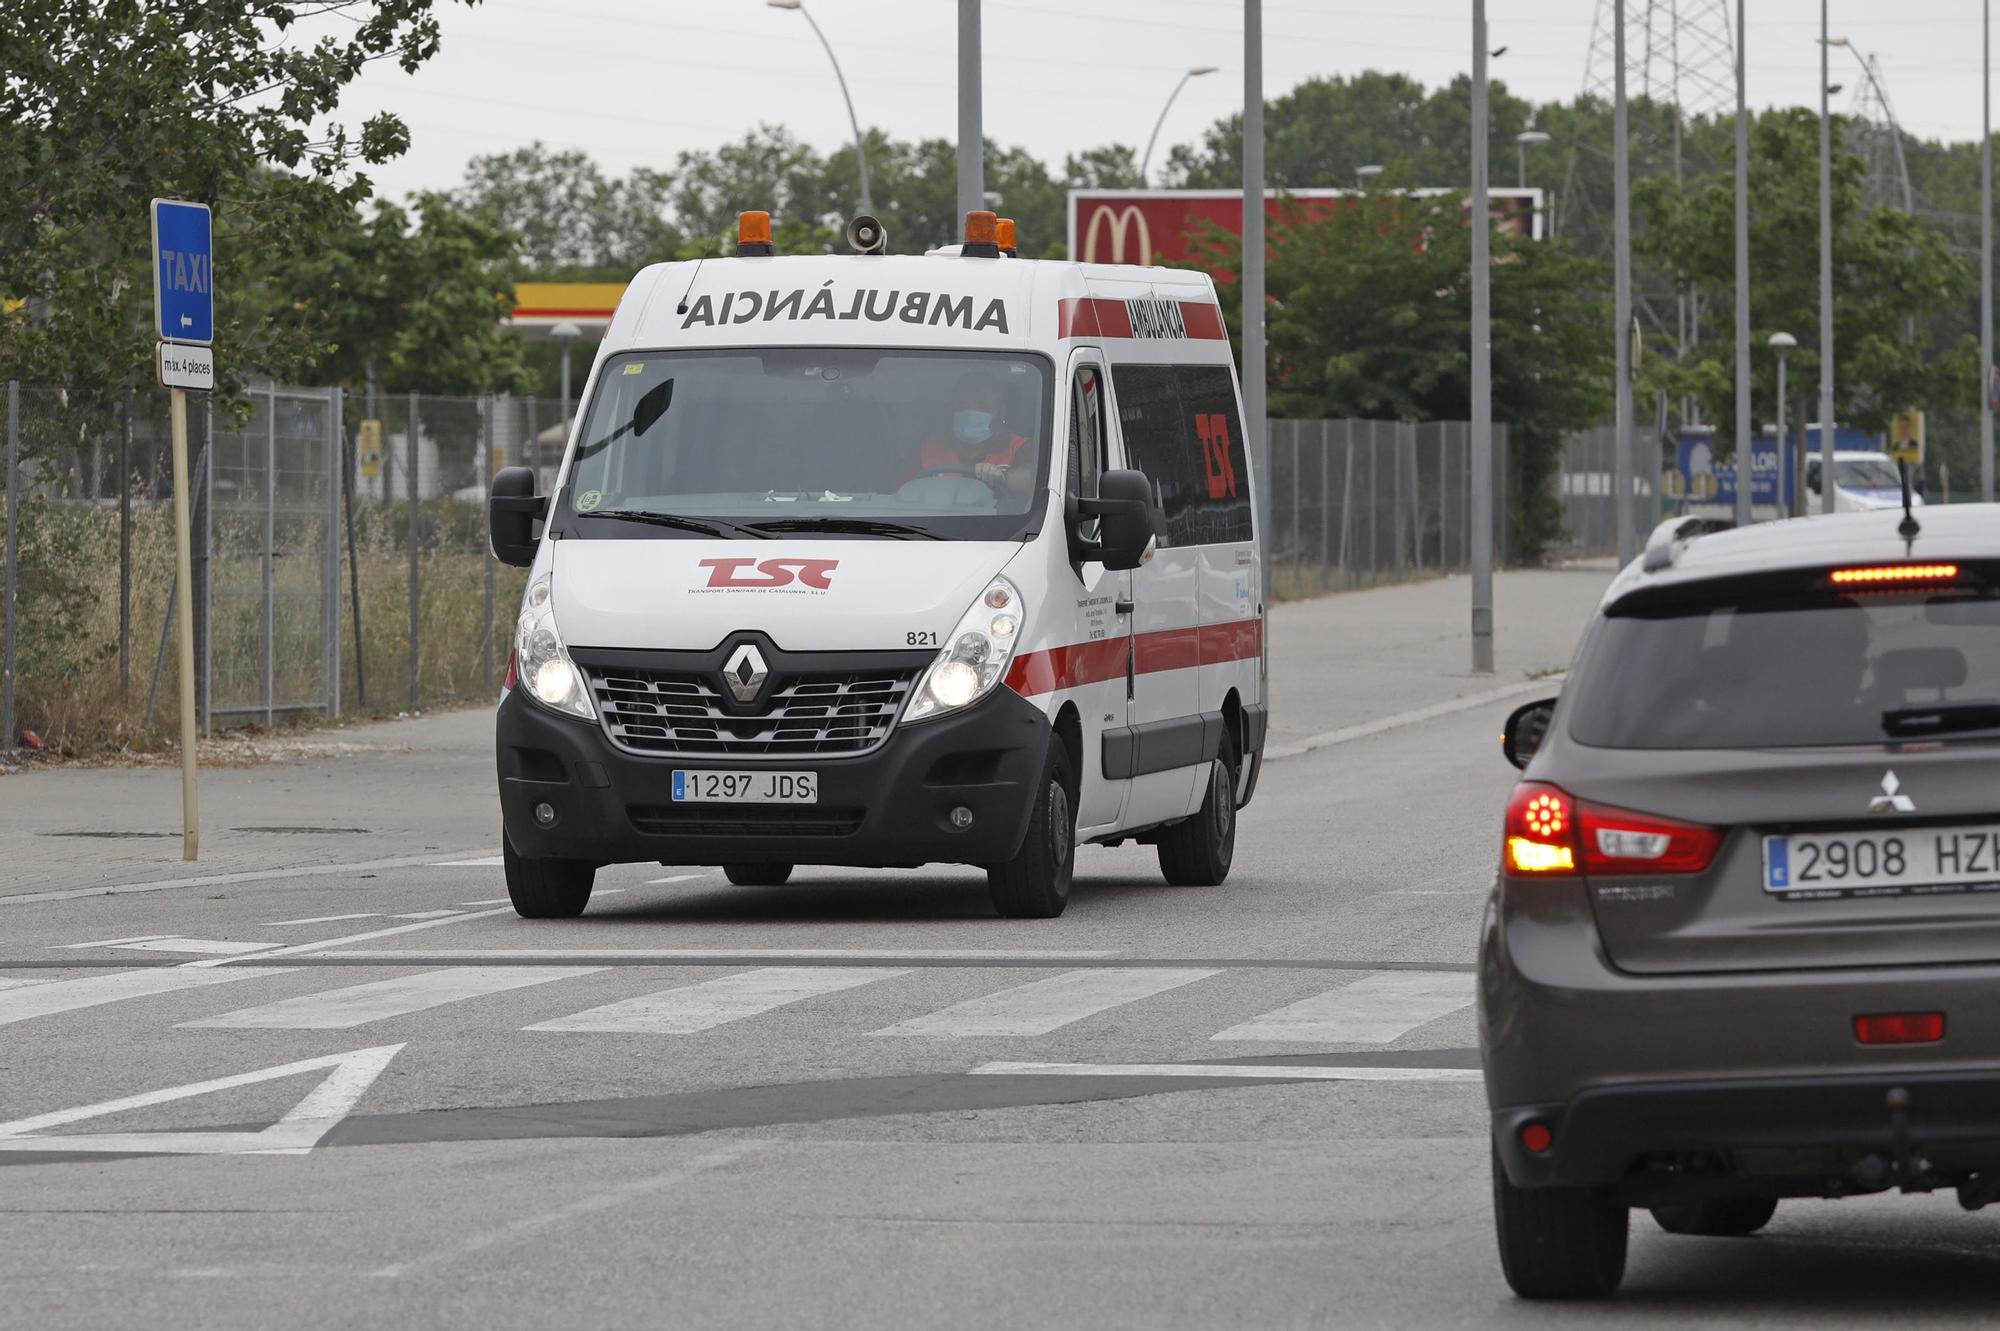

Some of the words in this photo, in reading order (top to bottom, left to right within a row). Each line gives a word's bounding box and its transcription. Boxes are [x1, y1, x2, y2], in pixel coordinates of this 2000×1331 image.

[162, 250, 208, 294] TAXI
[182, 358, 187, 372] 4
[188, 359, 211, 376] places
[698, 557, 839, 590] TSC
[906, 631, 937, 646] 821
[691, 774, 753, 798] 1297
[763, 775, 811, 799] JDS
[1797, 837, 1907, 882] 2908
